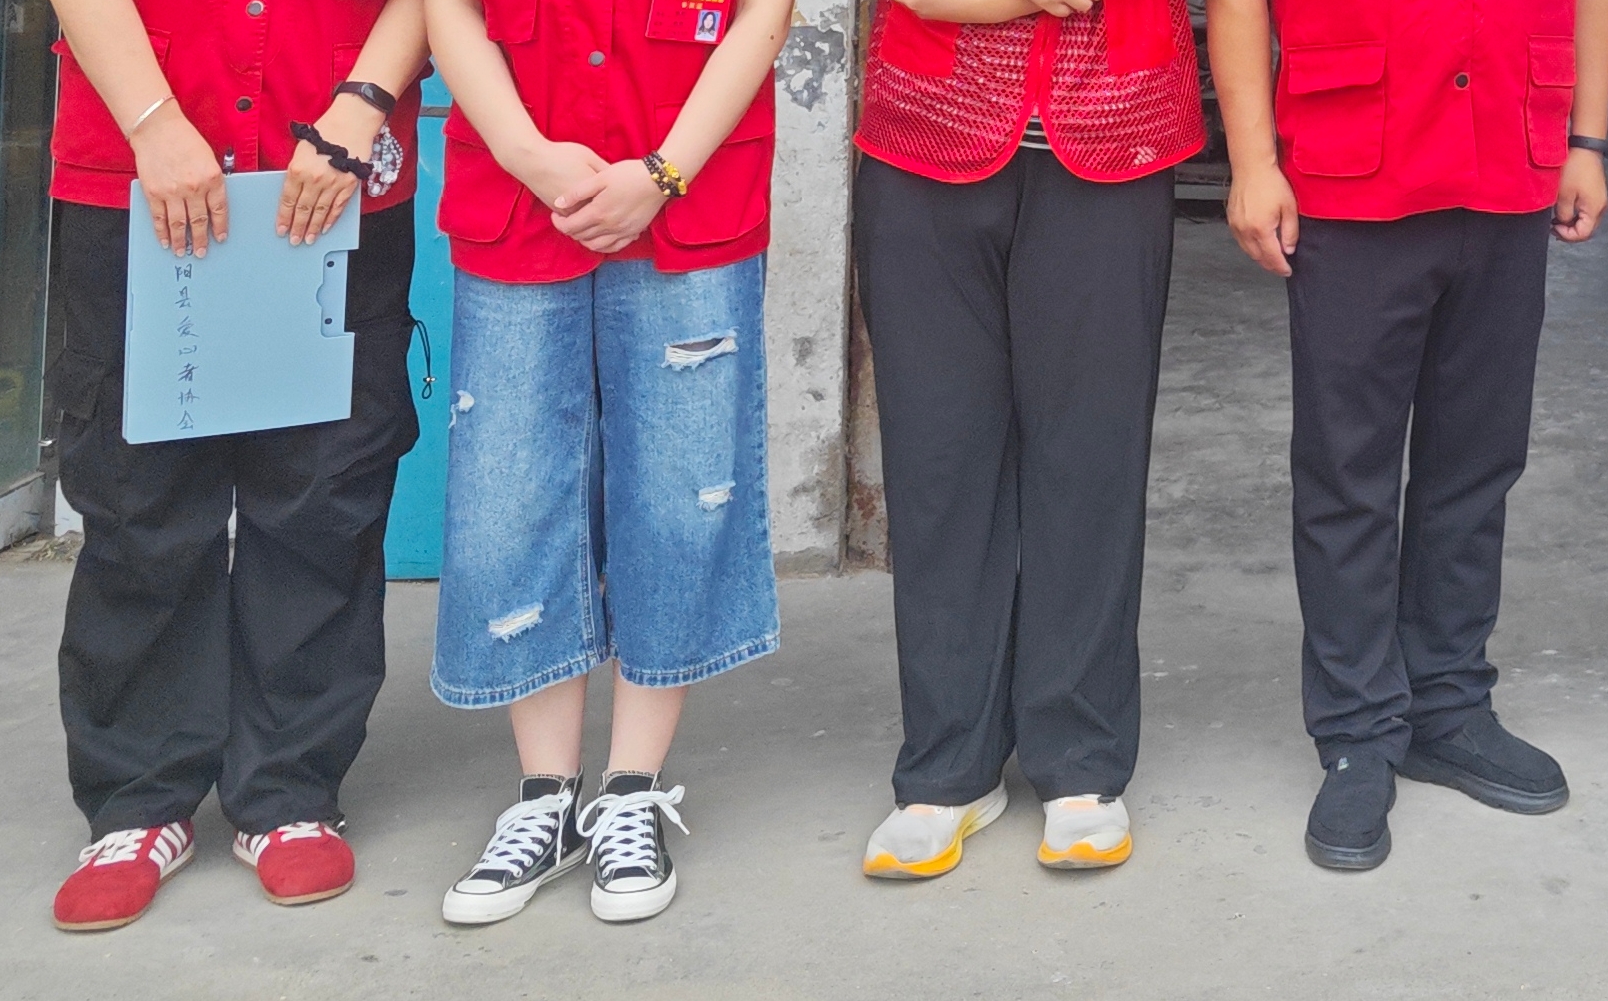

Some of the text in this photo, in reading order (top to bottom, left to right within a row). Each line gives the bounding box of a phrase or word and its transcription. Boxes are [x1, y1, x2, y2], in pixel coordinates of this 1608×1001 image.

[174, 237, 201, 431] 阳县爱心者协会
